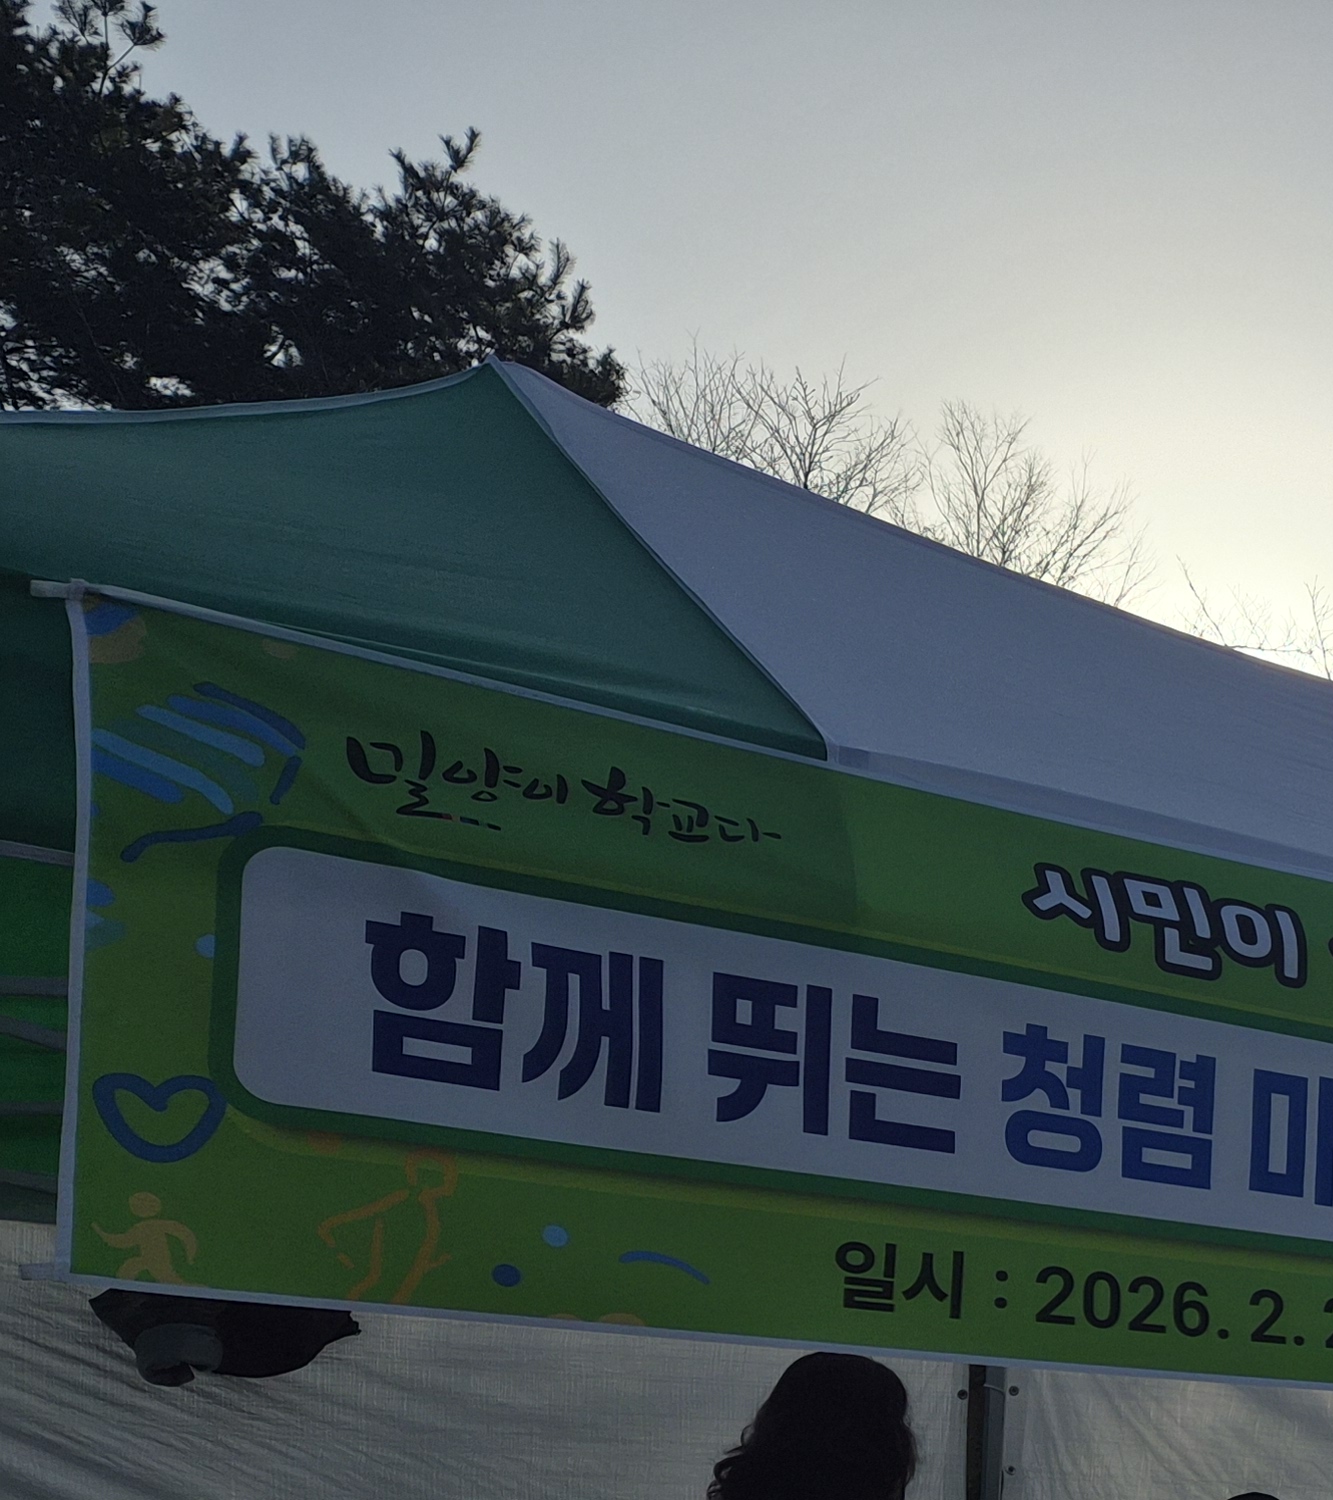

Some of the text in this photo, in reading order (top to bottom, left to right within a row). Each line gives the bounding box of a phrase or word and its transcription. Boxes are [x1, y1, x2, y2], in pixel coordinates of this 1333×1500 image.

[1022, 863, 1307, 987] 시민이
[366, 911, 664, 1114] 함께
[707, 971, 961, 1154] 뛰는
[1001, 1023, 1216, 1191] 청렴
[835, 1240, 964, 1319] 일시
[1035, 1267, 1230, 1341] 2026.
[1249, 1289, 1306, 1346] 2.
